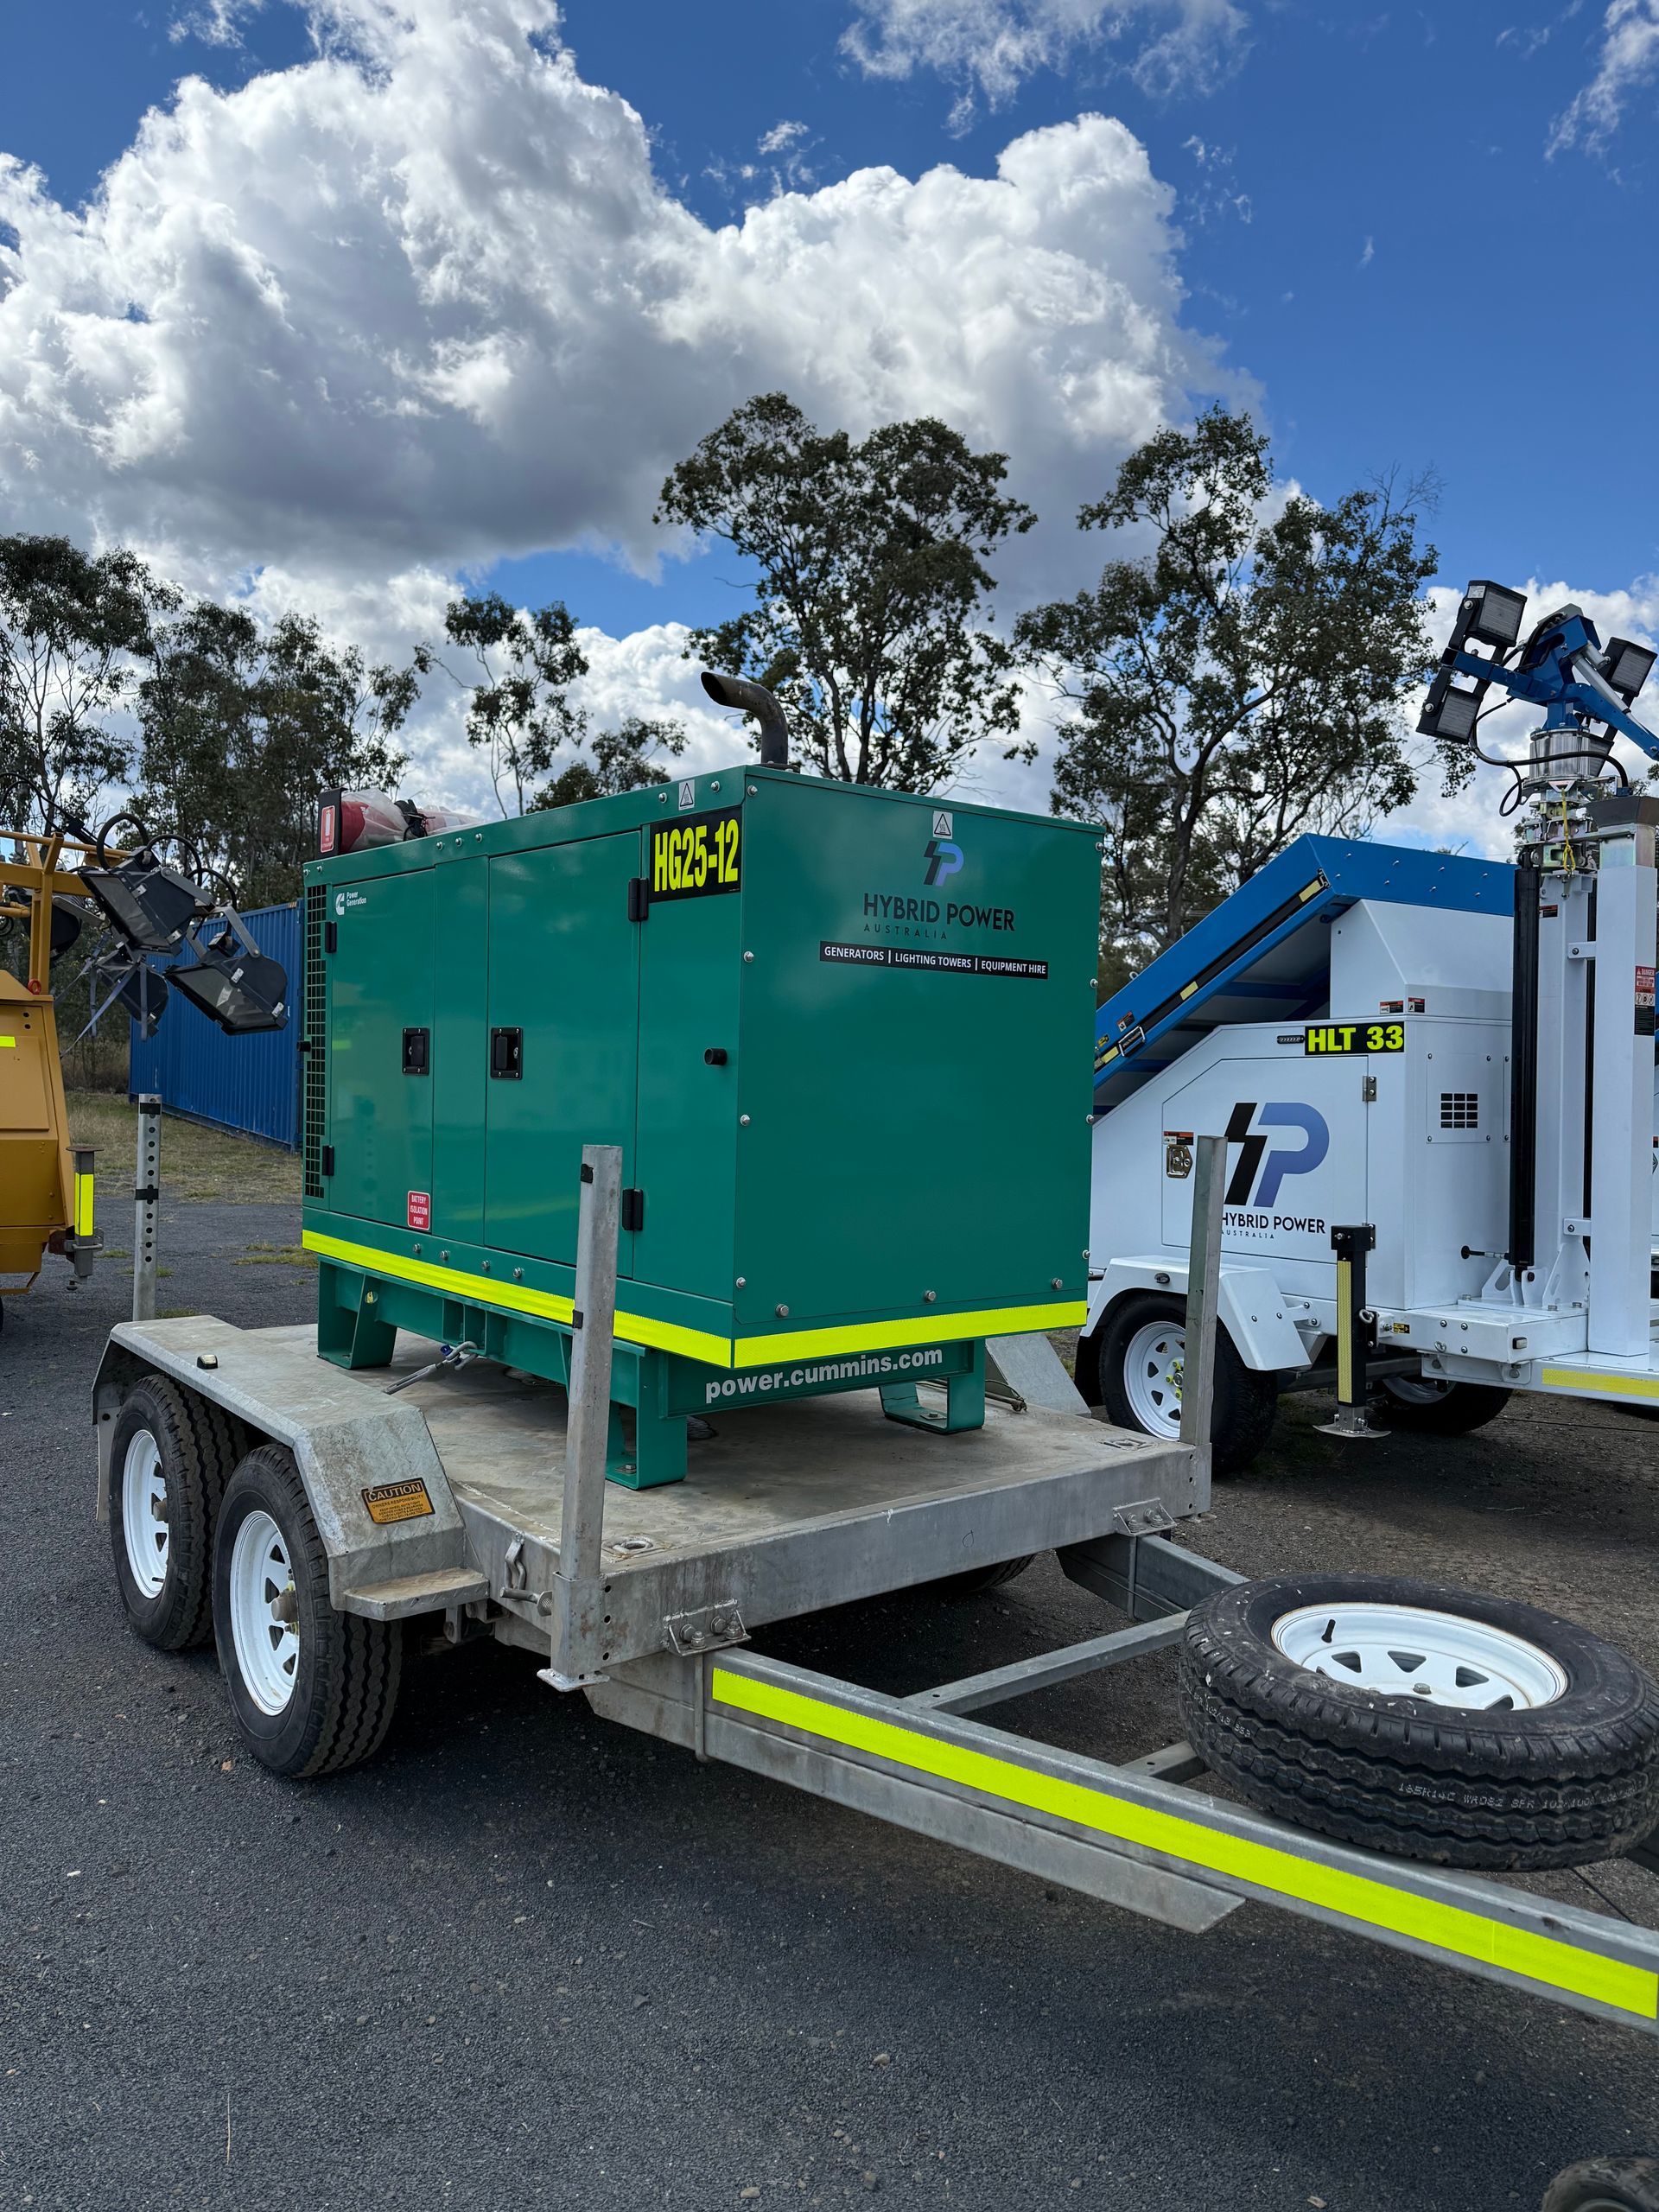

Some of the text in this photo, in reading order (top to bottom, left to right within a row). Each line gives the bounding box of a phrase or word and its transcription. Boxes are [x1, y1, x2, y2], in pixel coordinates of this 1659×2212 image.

[654, 819, 739, 892] HG25-12
[864, 893, 1015, 931] HYBRID POWER
[864, 924, 947, 940] AUSTRALIA
[824, 946, 1046, 975] GENERATORS LIGHTING TOWERS EQUIPMENT HIRE
[1308, 1025, 1403, 1052] HLT 33
[1222, 1212, 1326, 1234] HYBRID POWER
[705, 1349, 943, 1404] power.cummins.com
[368, 1483, 422, 1502] CAUTION
